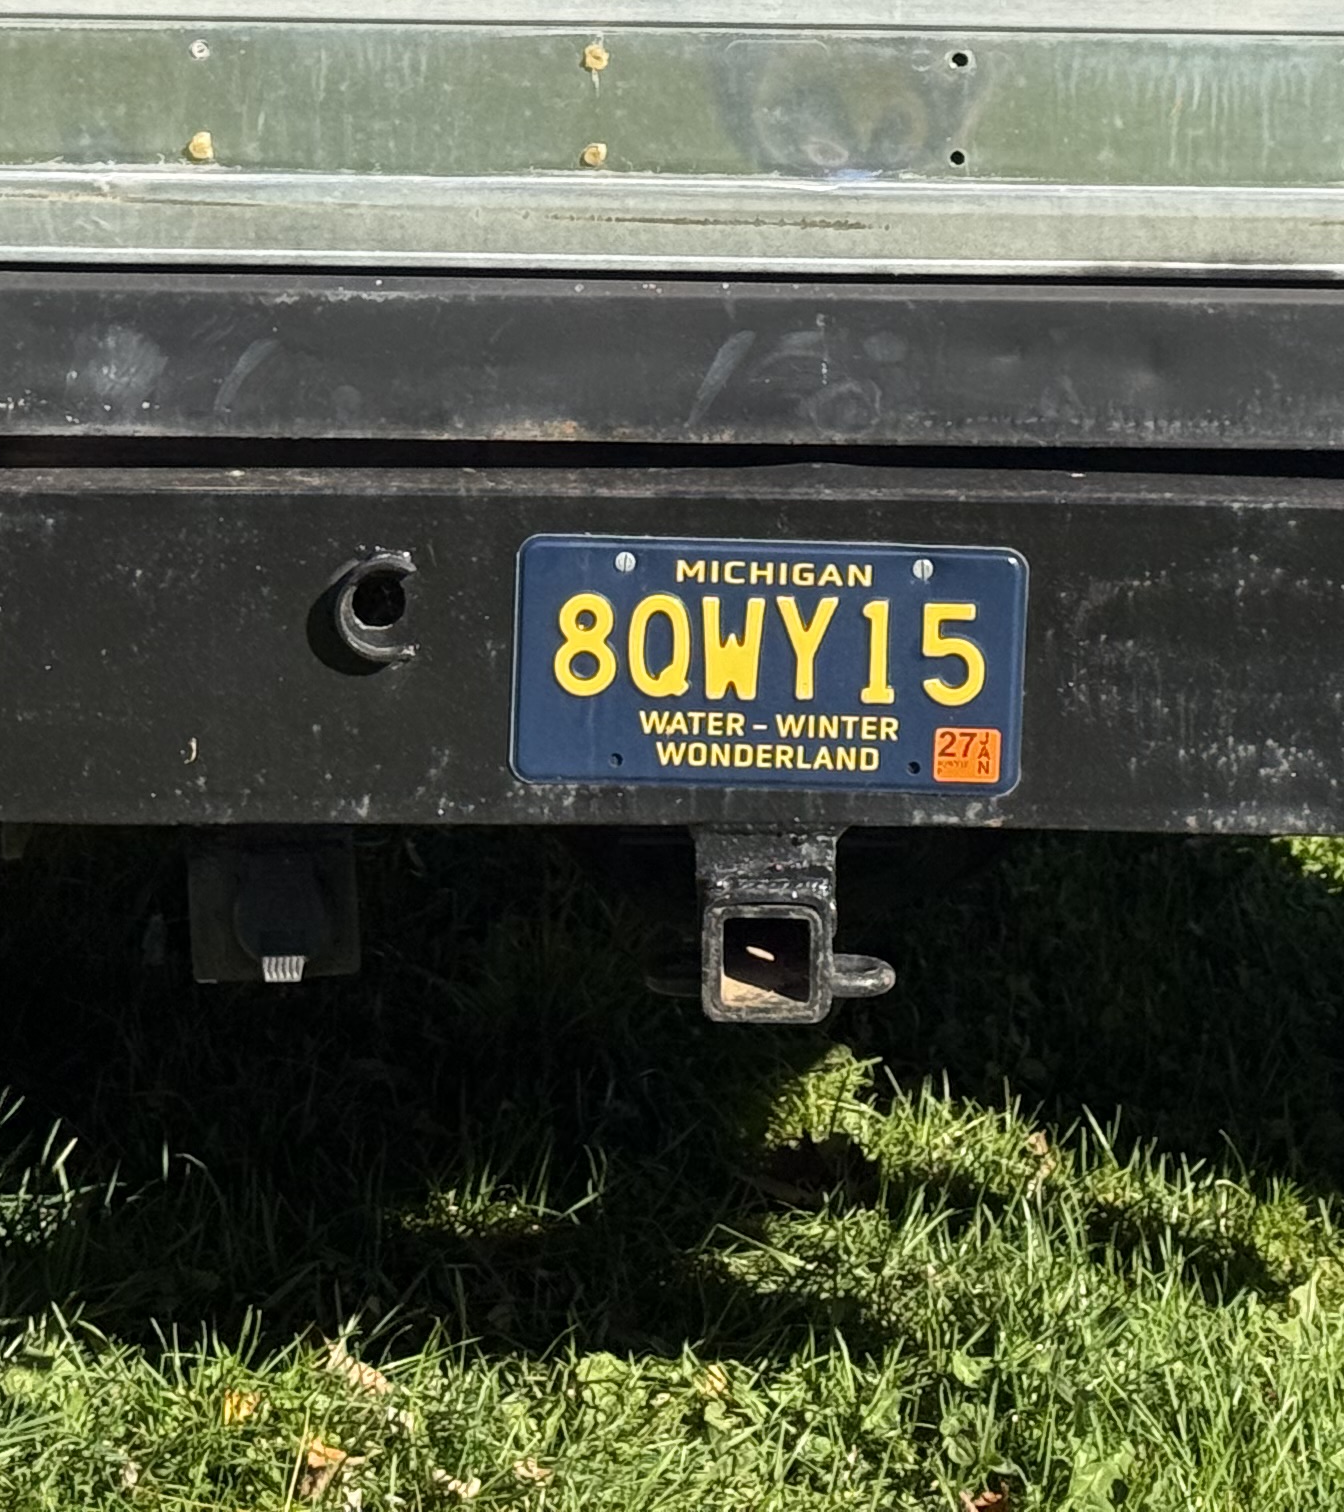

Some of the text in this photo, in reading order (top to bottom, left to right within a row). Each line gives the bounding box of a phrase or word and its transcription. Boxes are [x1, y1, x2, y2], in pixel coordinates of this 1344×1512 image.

[676, 559, 873, 587] MICHIGAN
[553, 592, 986, 707] 8QWY15
[639, 710, 745, 737] WATER
[775, 714, 899, 741] WINTER
[656, 741, 880, 771] WONDERLAND
[938, 731, 978, 758] 27
[977, 732, 991, 775] JAN
